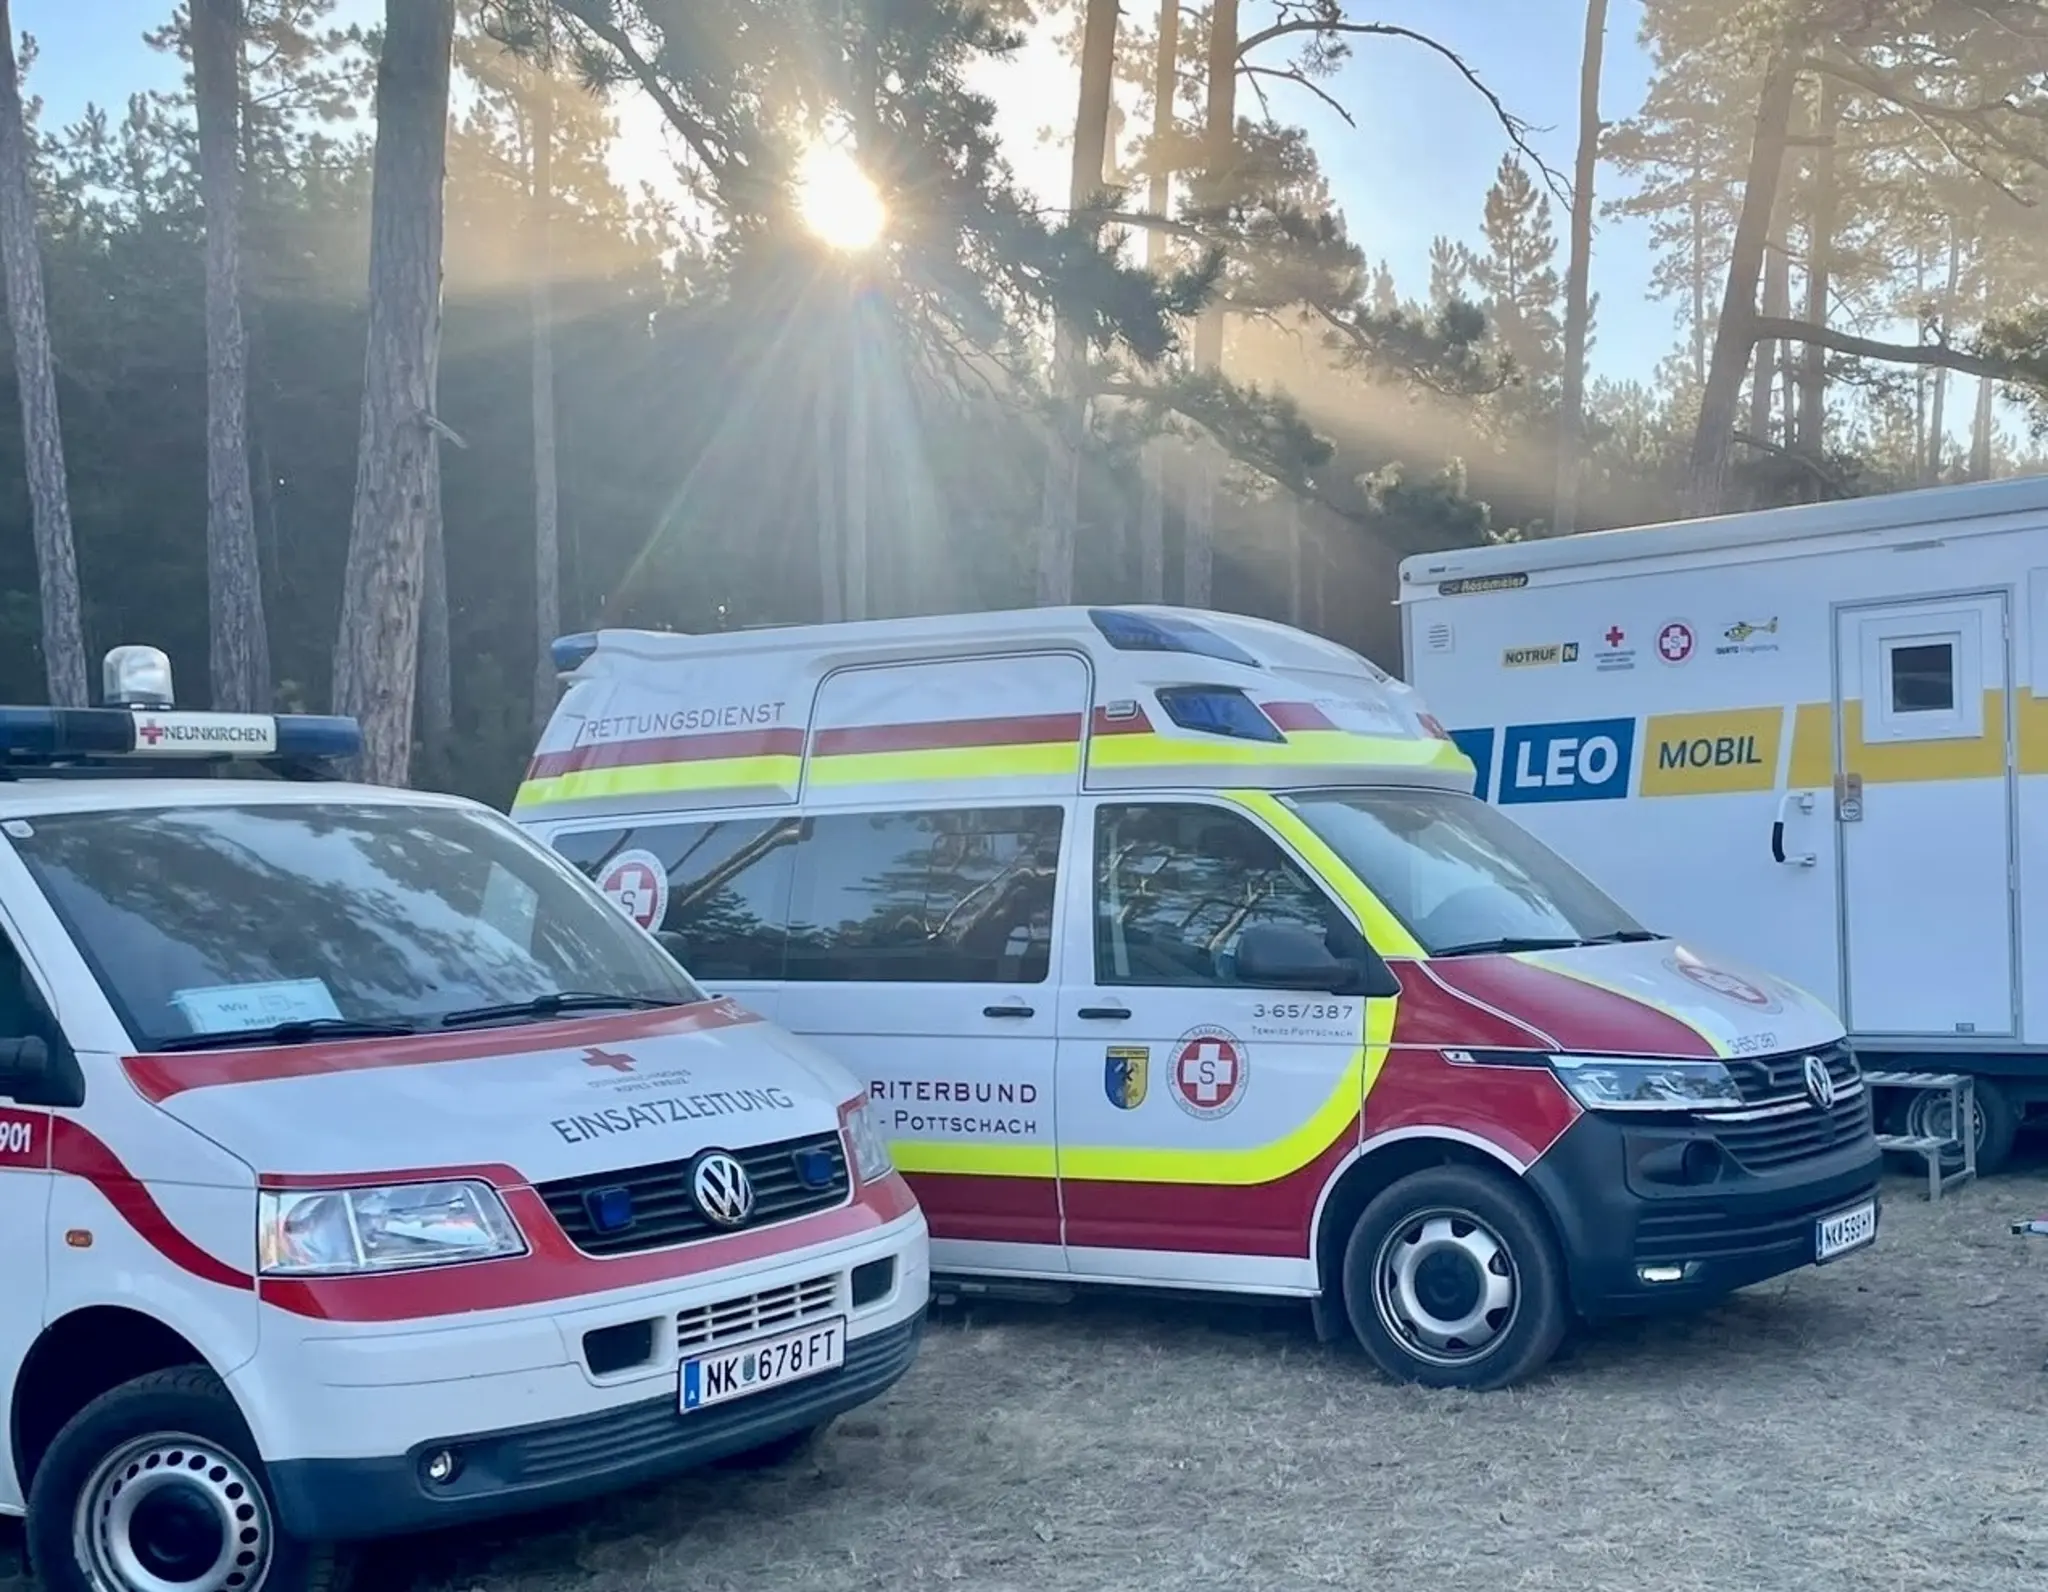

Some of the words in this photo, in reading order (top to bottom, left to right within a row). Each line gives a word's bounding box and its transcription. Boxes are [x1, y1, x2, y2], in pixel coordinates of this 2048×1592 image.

[1505, 648, 1558, 664] NOTRUF
[164, 725, 268, 742] NEUNKIRCHEN
[585, 702, 785, 738] RETTUNGSDIENST
[1515, 735, 1619, 788] LEO
[1659, 735, 1763, 770] MOBIL
[1199, 1060, 1216, 1085] S
[870, 1080, 1037, 1104] RITERBUND
[550, 1087, 795, 1144] EINSATZLEITUNG
[0, 1121, 32, 1153] 901
[706, 1356, 739, 1398] NK
